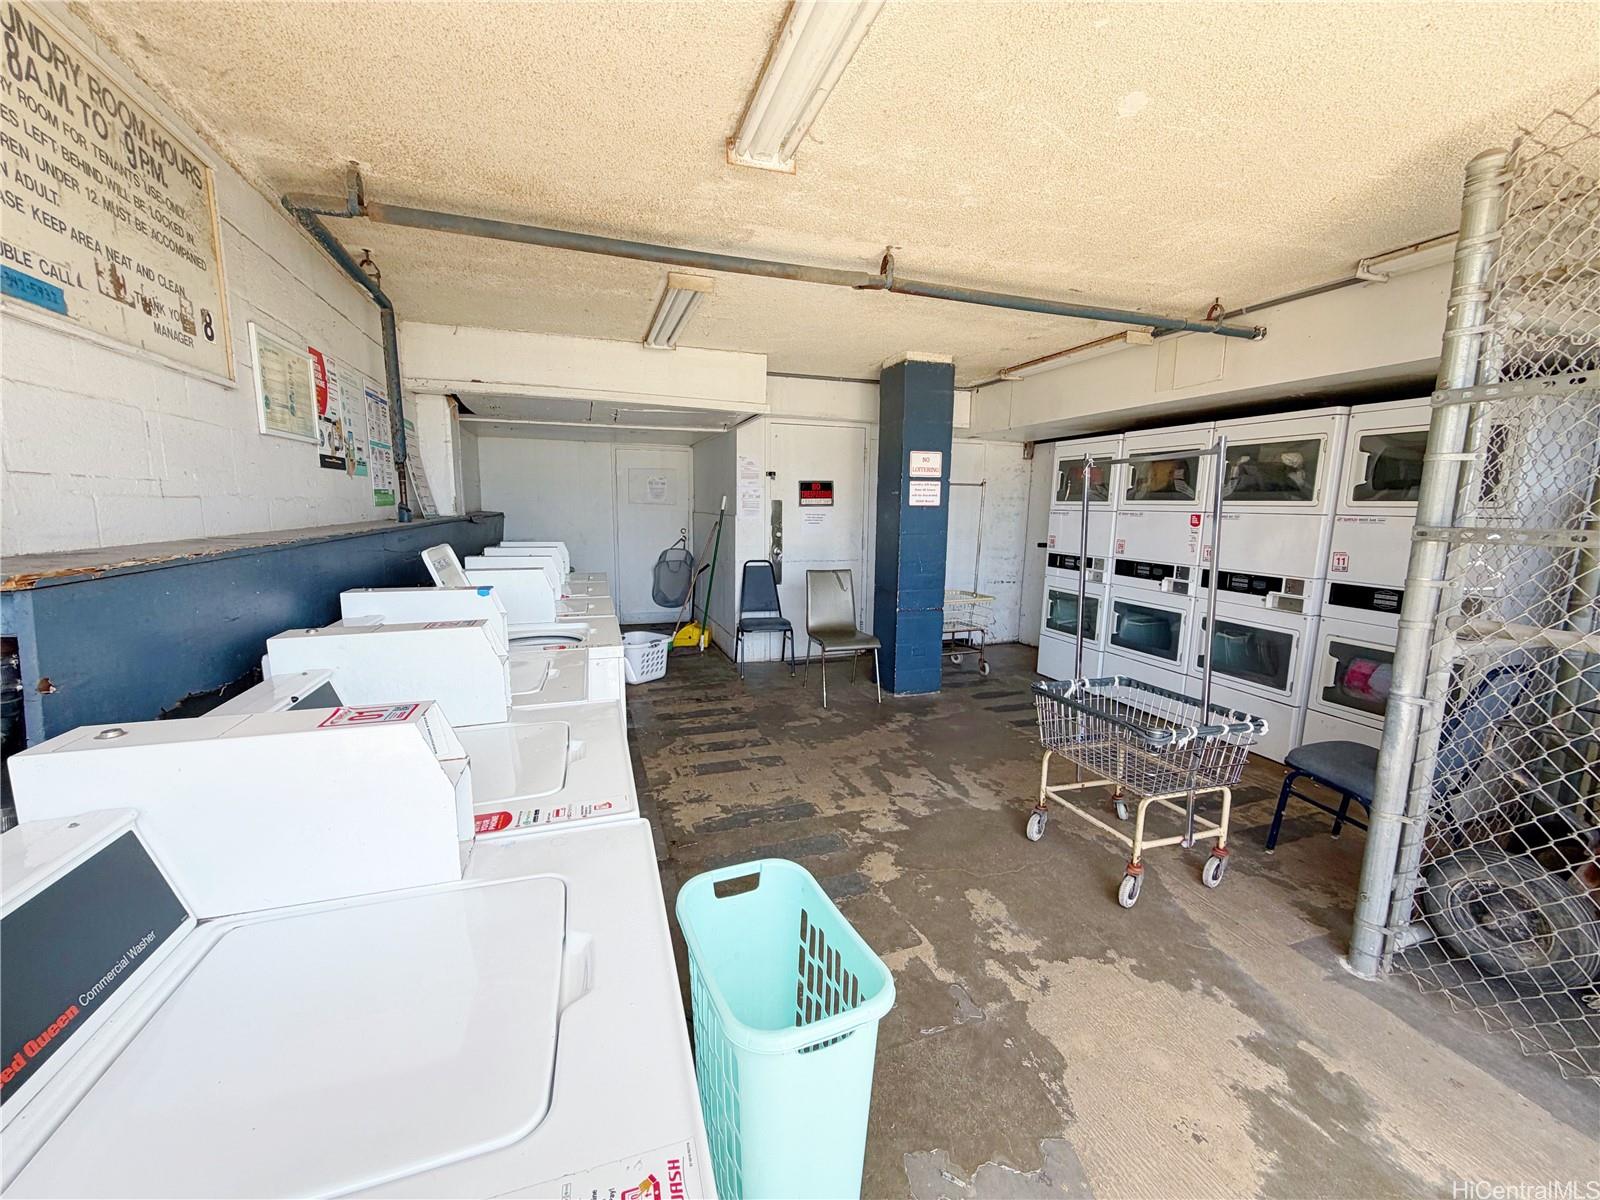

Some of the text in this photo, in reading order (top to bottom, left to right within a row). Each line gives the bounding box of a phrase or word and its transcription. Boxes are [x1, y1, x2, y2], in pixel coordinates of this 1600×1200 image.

[4, 31, 23, 82] 8
[76, 94, 108, 140] TO
[124, 130, 137, 170] 9
[17, 86, 59, 131] ROOM
[63, 121, 89, 151] FOR
[86, 73, 149, 147] ROOM
[150, 128, 203, 190] HOURS
[23, 119, 57, 154] LEFT
[61, 145, 104, 185] BEHIND
[105, 175, 131, 203] WILL
[133, 194, 147, 214] BE
[149, 205, 185, 238] LOCKED
[35, 153, 81, 194] UNDER
[85, 186, 99, 206] 12
[102, 196, 131, 225] MUST
[135, 217, 148, 235] BE
[31, 204, 67, 234] KEEP
[70, 227, 103, 256] AREA
[105, 245, 132, 271] NEAT
[136, 263, 155, 281] AND
[39, 258, 75, 288] CALL
[153, 321, 195, 348] MANAGER
[203, 312, 215, 342] 8
[1336, 557, 1346, 565] 11
[23, 1004, 80, 1057] Queen
[78, 955, 129, 1007] Commercial
[126, 930, 157, 959] Washer
